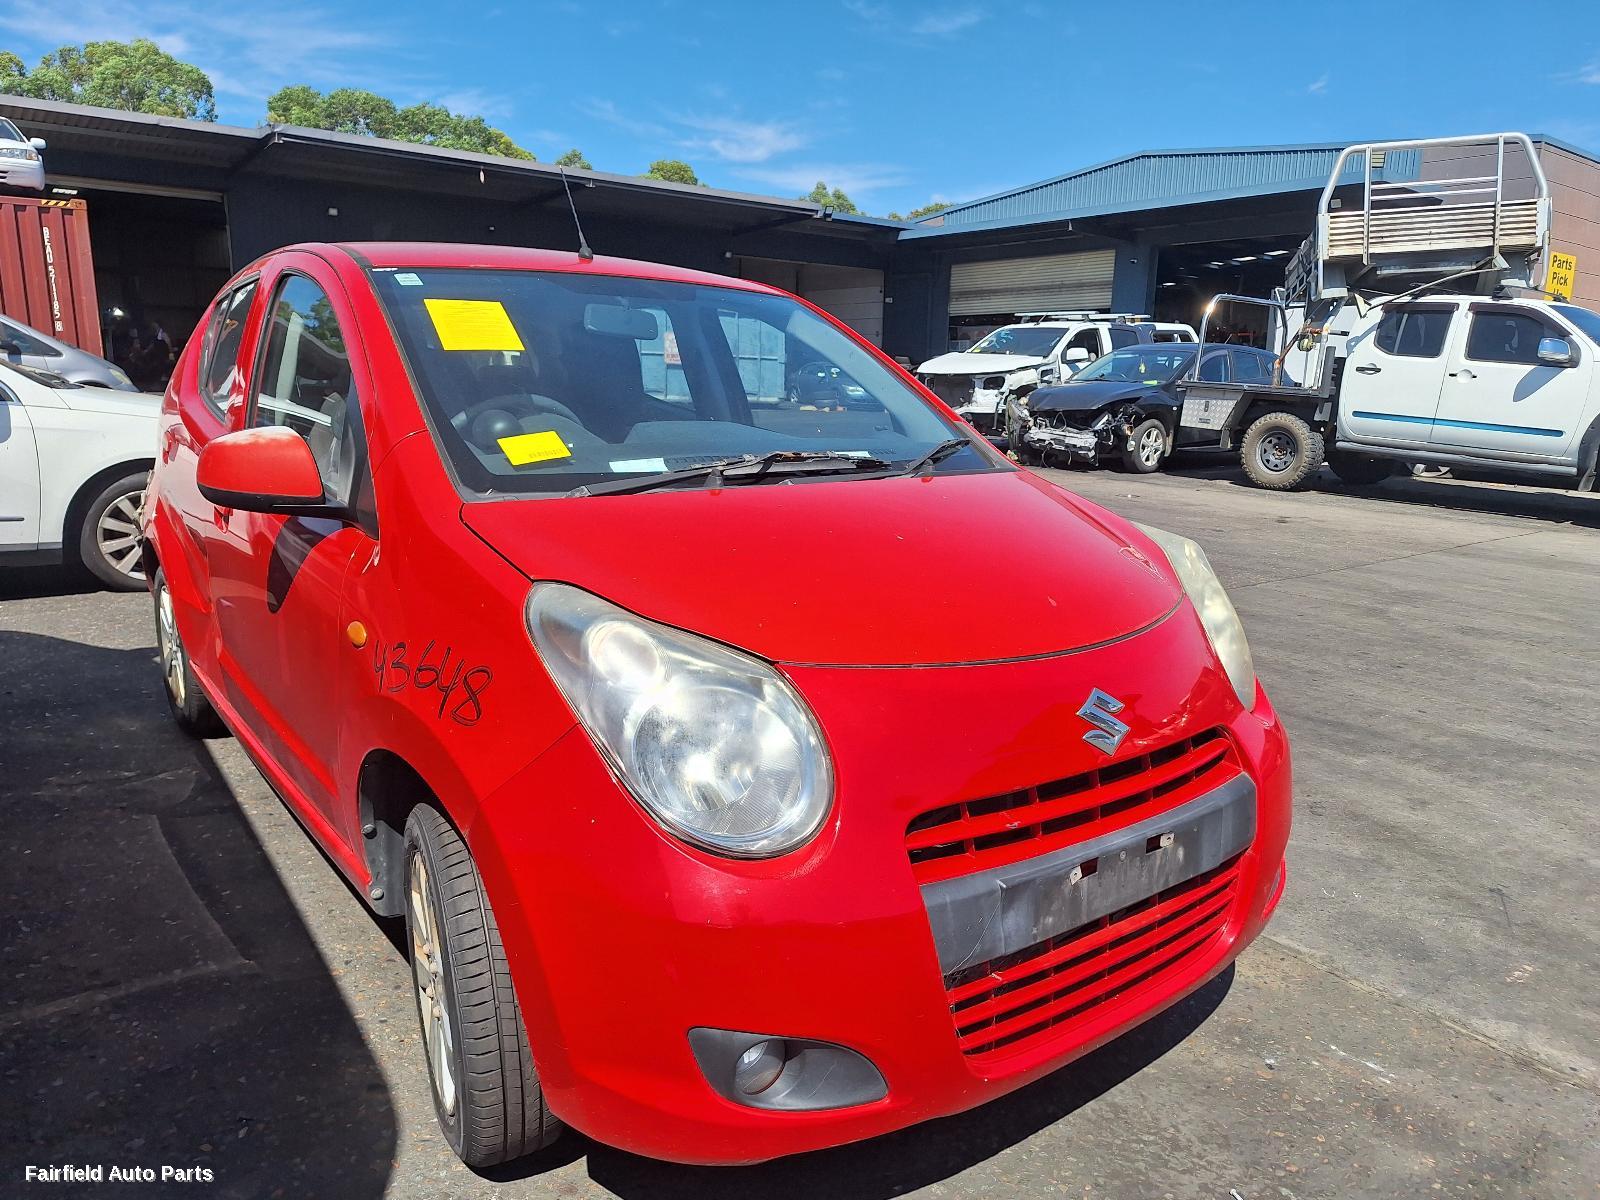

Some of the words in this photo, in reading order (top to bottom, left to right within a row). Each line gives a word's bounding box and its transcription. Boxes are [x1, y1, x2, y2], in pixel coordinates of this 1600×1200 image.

[1552, 255, 1572, 271] Parts
[1552, 271, 1568, 286] Pick
[373, 639, 493, 727] 43648
